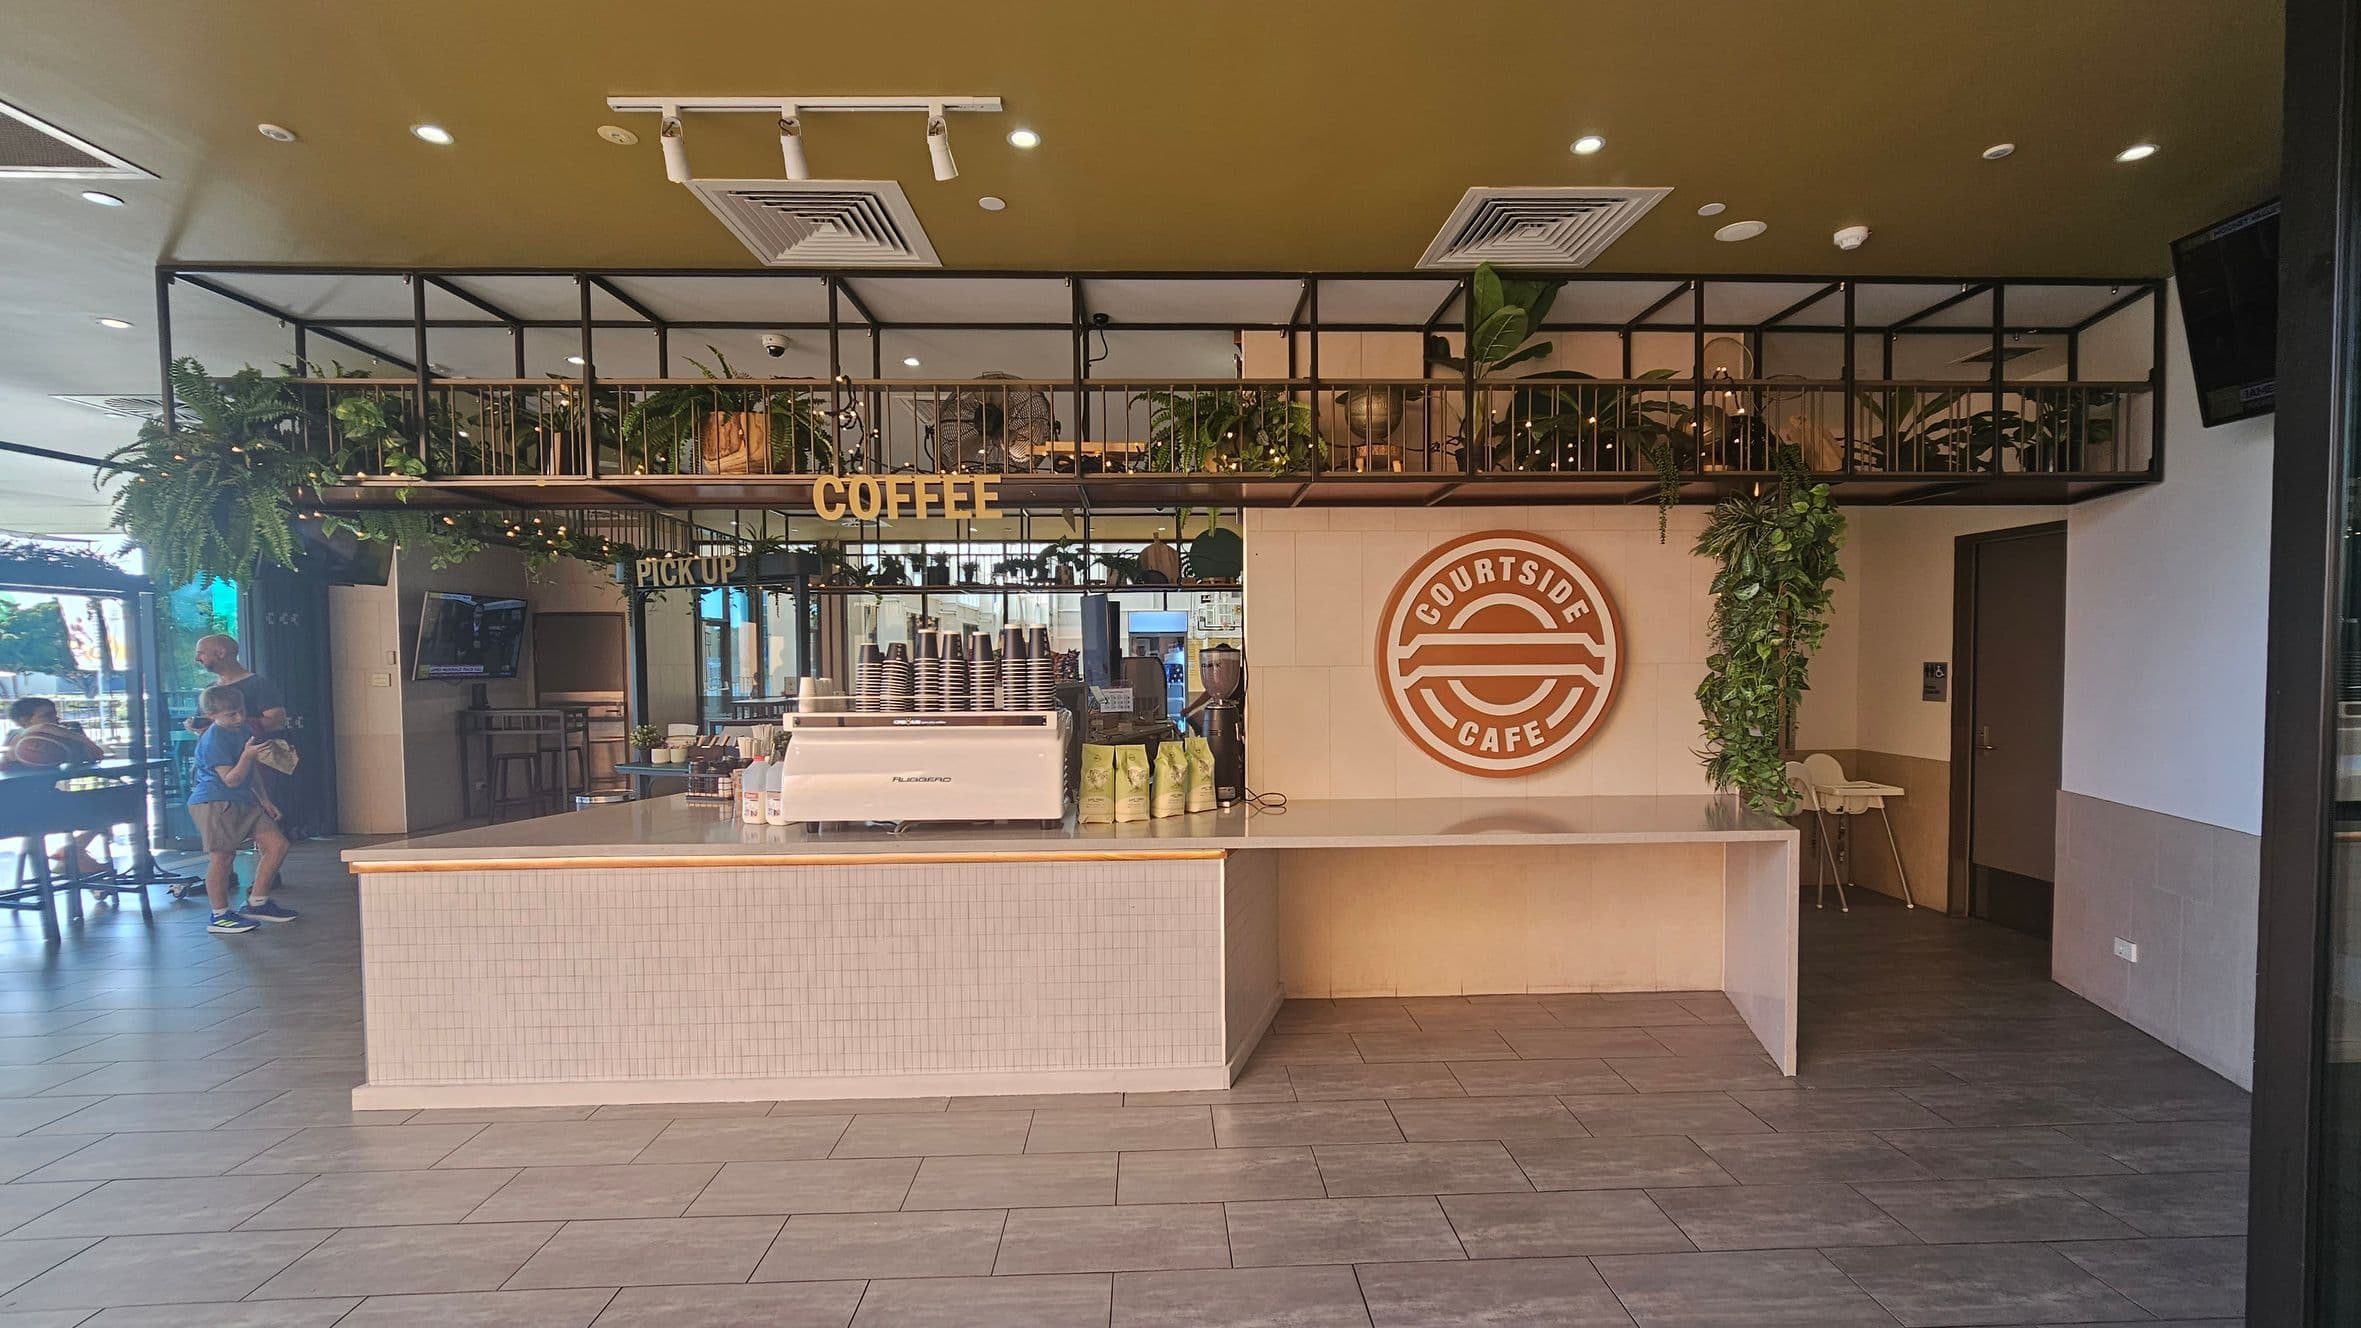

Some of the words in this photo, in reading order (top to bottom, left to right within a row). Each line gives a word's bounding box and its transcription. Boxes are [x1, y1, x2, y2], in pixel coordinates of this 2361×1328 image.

[813, 475, 1003, 521] COFFEE
[636, 557, 696, 588] PICK
[701, 556, 737, 585] UP
[1415, 556, 1590, 626] COURTSIDE
[1458, 719, 1545, 753] CAFE
